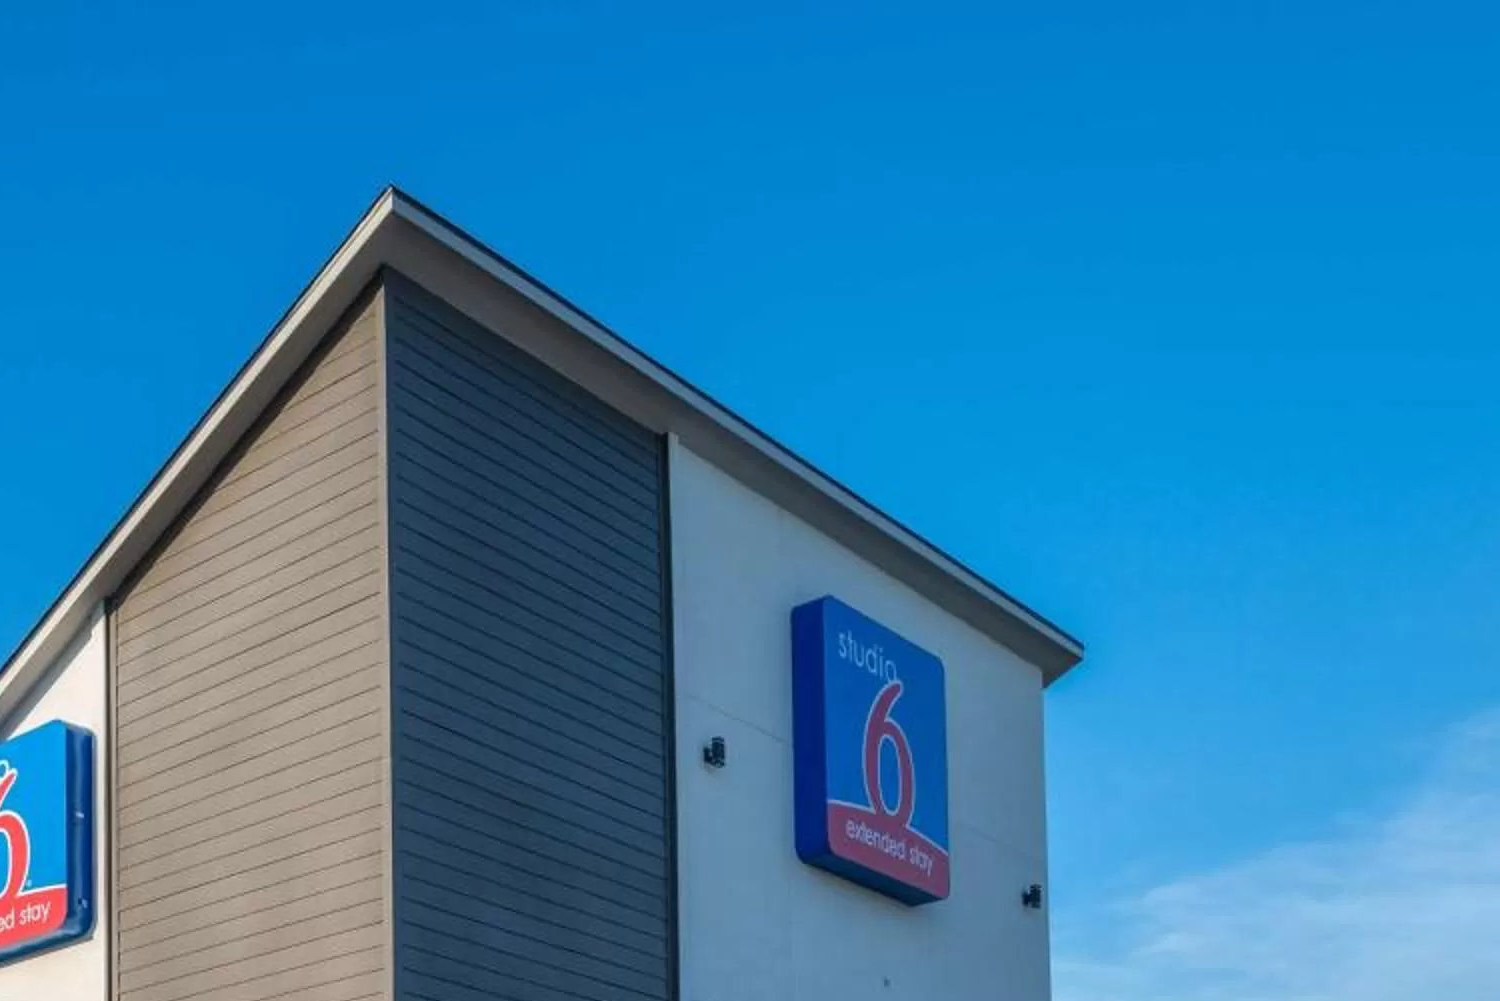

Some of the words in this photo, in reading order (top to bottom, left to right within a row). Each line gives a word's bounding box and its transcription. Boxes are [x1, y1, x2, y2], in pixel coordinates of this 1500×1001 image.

[838, 630, 897, 683] studio
[862, 680, 916, 828] 6
[845, 817, 906, 860] extended
[909, 844, 933, 877] stay
[19, 902, 51, 925] stay
